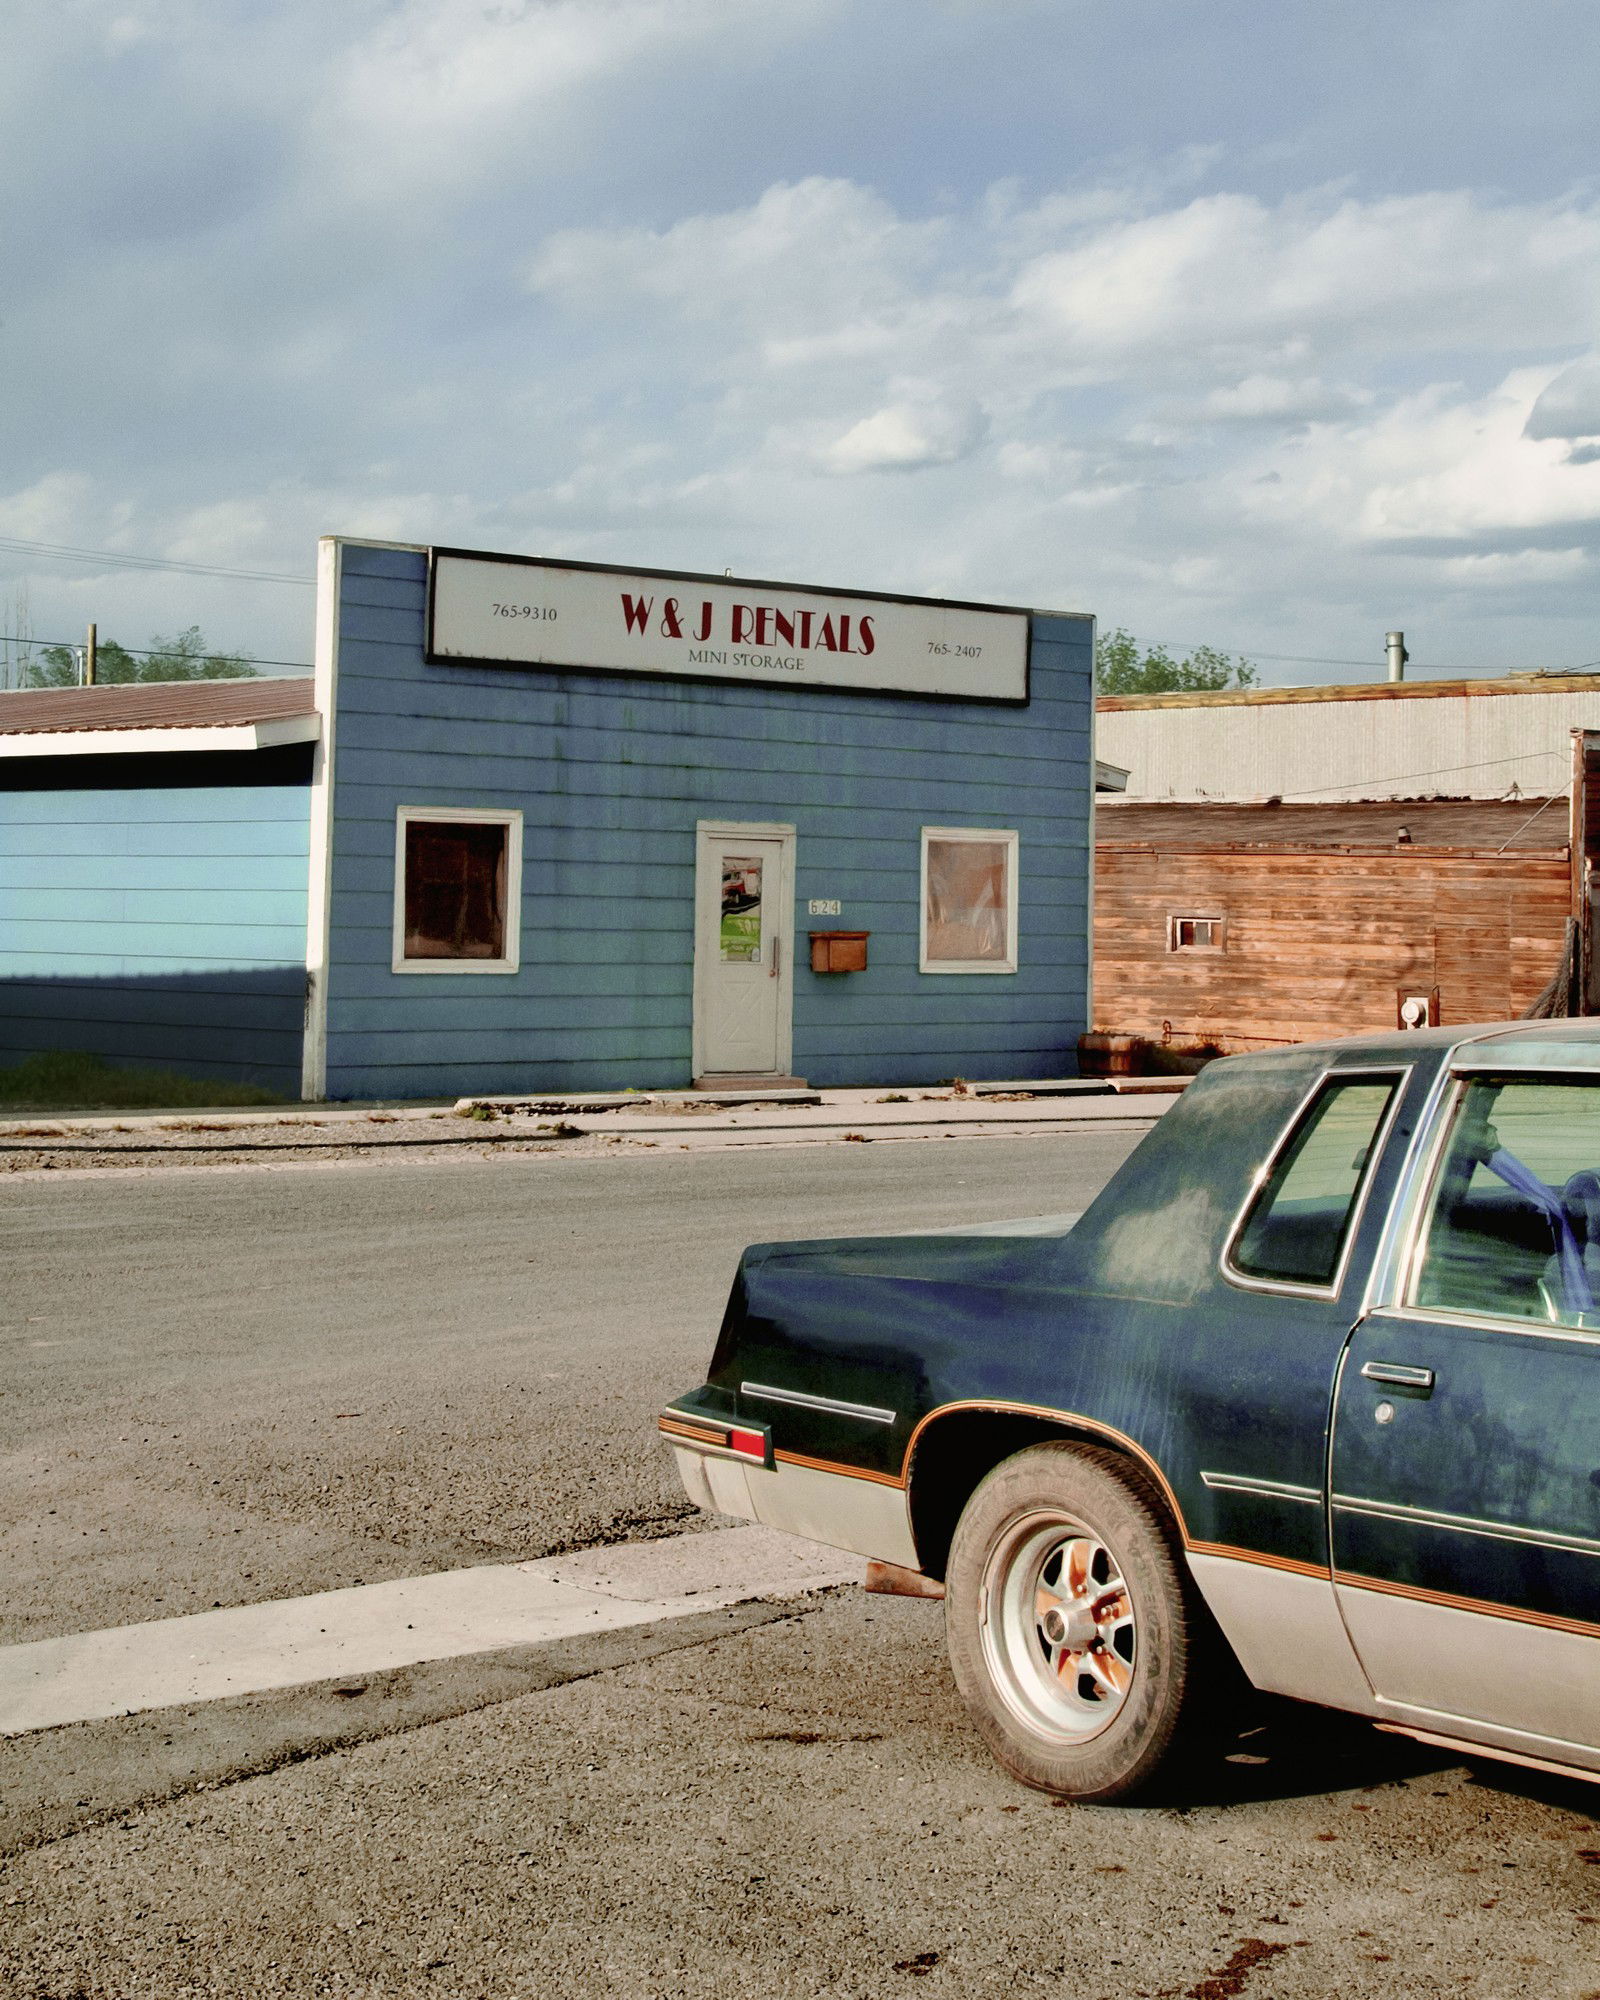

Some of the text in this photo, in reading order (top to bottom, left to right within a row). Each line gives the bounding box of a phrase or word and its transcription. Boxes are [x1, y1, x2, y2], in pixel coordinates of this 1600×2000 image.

[492, 603, 557, 622] 765-9310
[621, 593, 875, 656] W & J RENTALS
[688, 649, 805, 671] MINI STORAGE
[811, 901, 838, 914] 624
